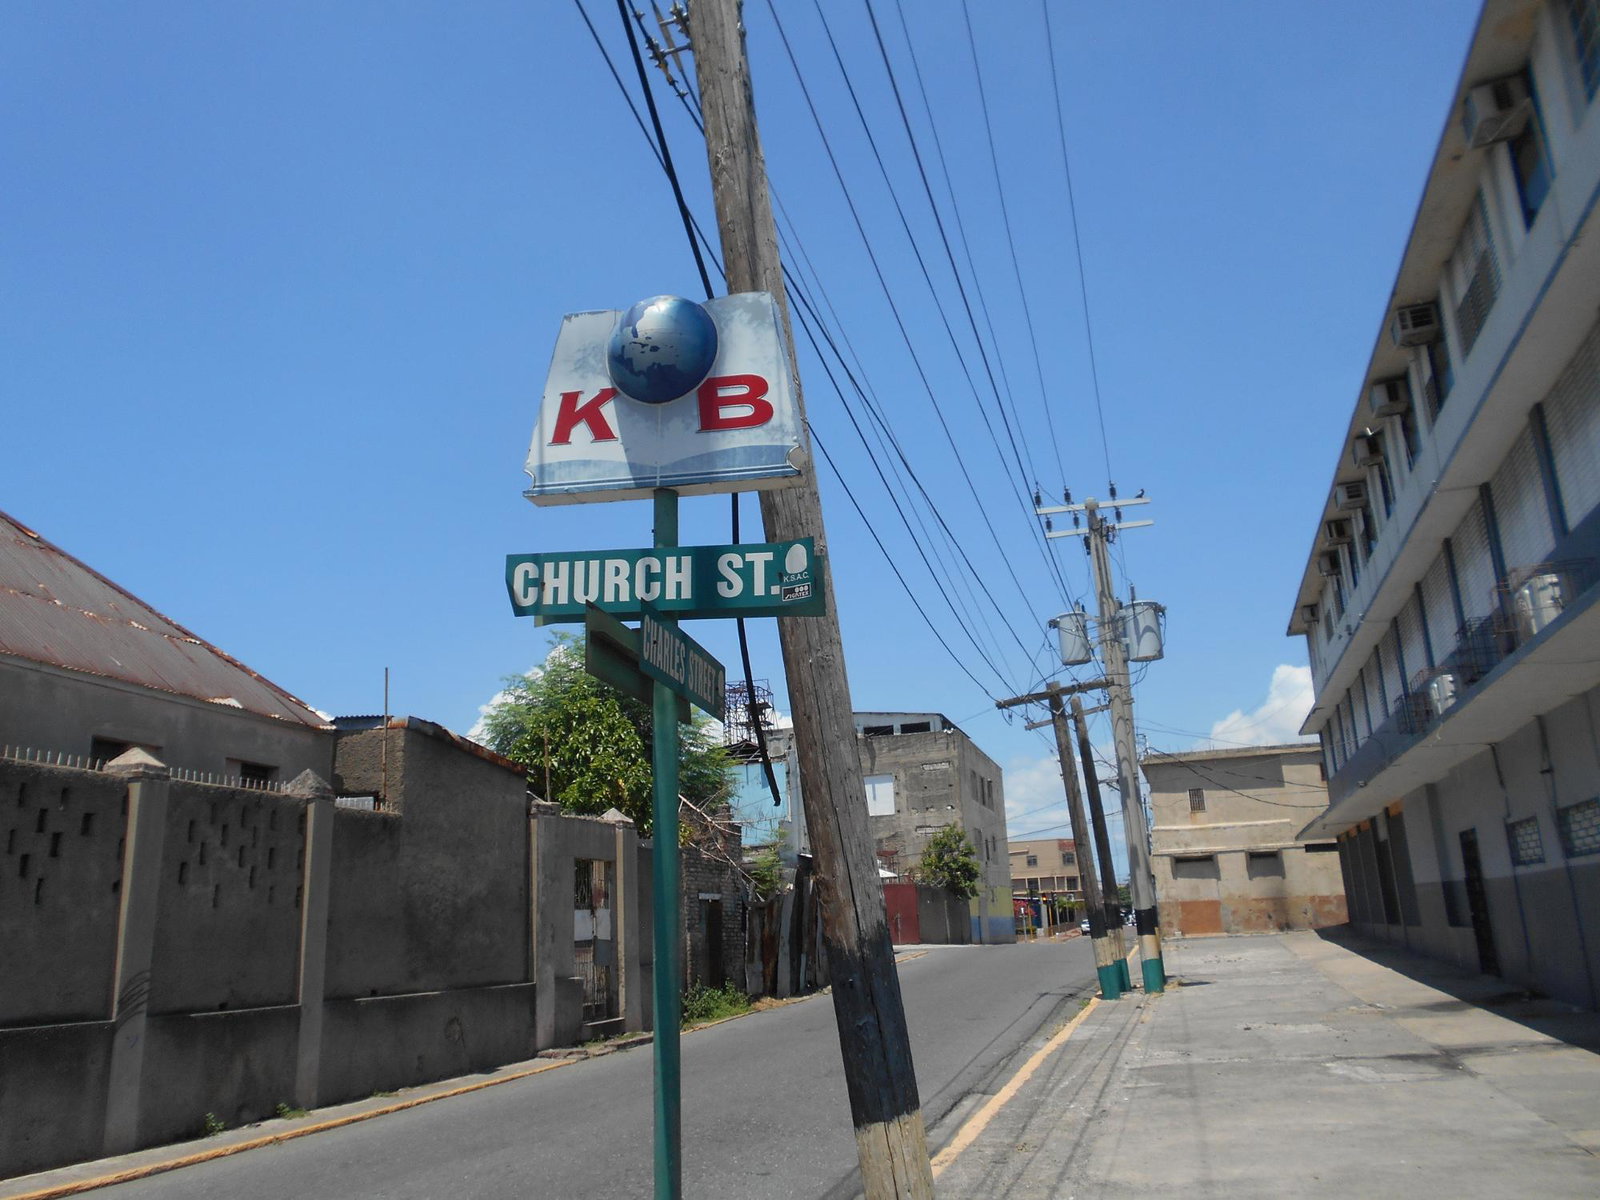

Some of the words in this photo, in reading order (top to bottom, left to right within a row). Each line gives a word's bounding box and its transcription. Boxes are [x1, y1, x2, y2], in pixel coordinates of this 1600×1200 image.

[548, 387, 618, 446] K
[697, 374, 774, 433] B
[513, 555, 692, 607] CHURCH
[717, 552, 780, 598] ST.
[643, 614, 686, 685] CHARLES
[688, 649, 716, 705] STREET
